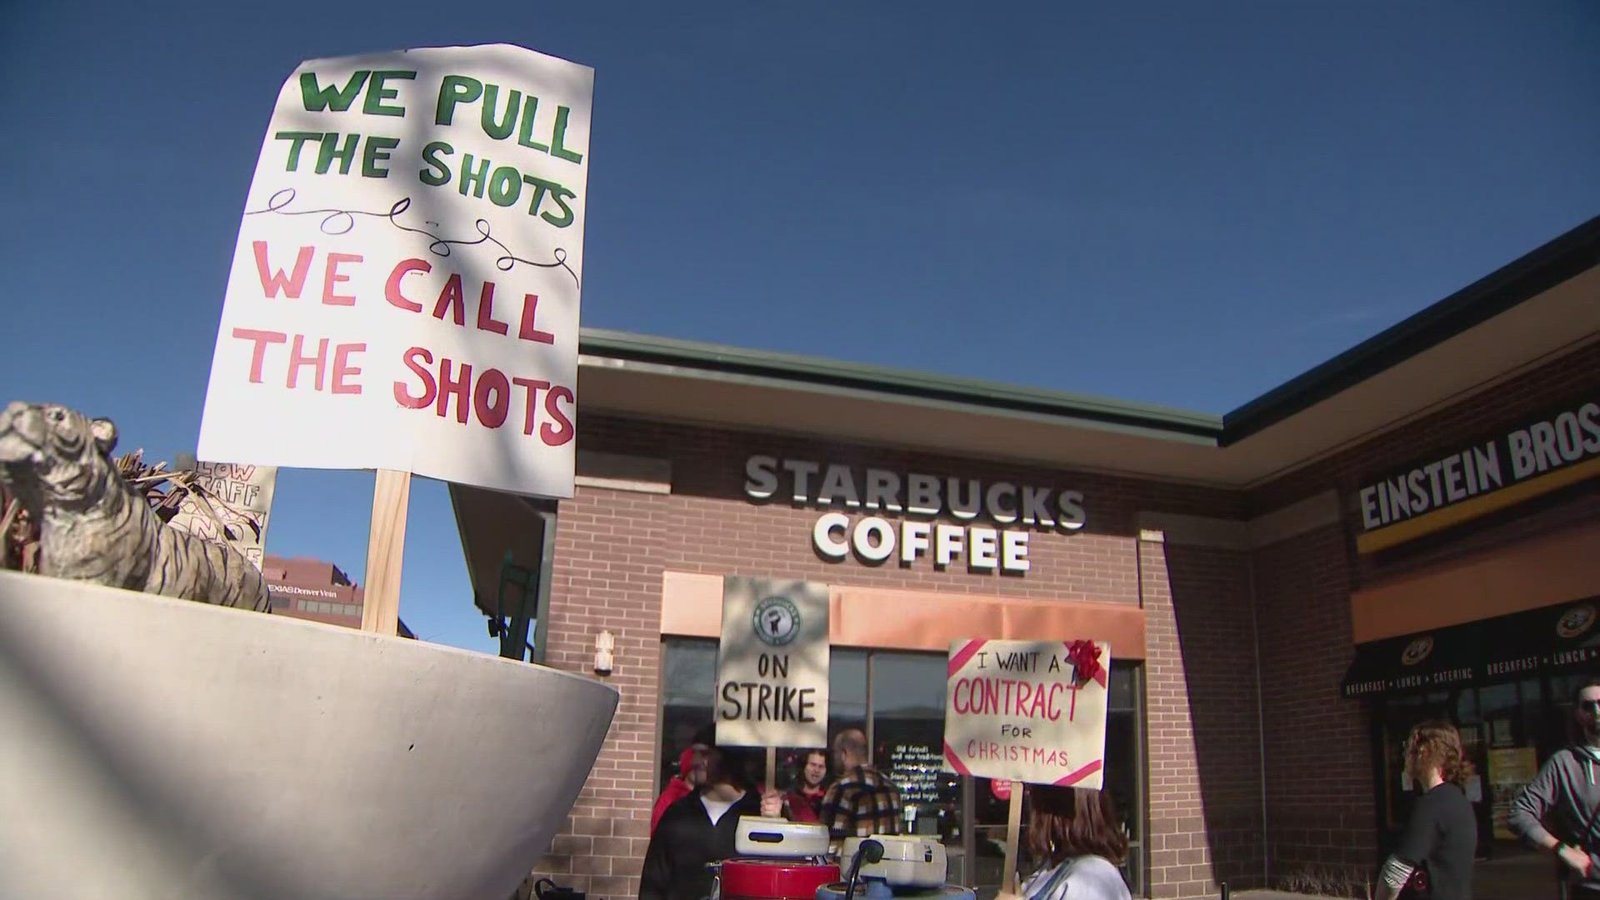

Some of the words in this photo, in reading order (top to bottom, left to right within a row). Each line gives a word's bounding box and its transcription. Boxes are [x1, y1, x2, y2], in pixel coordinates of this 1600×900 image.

[300, 71, 416, 117] WE
[435, 75, 583, 164] PULL
[275, 131, 400, 178] THE
[419, 141, 577, 228] SHOTS
[253, 240, 363, 306] WE
[384, 258, 554, 345] CALL
[232, 327, 367, 394] THE
[393, 346, 574, 447] SHOTS
[1359, 440, 1503, 530] EINSTEIN
[1507, 402, 1600, 480] BROS
[196, 475, 260, 506] TAFF
[744, 455, 1086, 529] STARBUCKS
[813, 513, 1030, 571] COFFEE
[758, 653, 789, 678] ON
[977, 652, 988, 669] I
[996, 652, 1040, 673] WANT
[1048, 654, 1060, 673] A
[1346, 680, 1385, 695] BREAKFAST
[1396, 676, 1421, 689] LUNCH
[1433, 668, 1472, 684] CATERING
[1487, 656, 1537, 675] BREAKFAST
[1553, 649, 1586, 665] LUNCH
[722, 681, 816, 723] STRIKE
[953, 677, 1082, 722] CONTRACT
[1001, 724, 1032, 738] FOR
[967, 739, 1068, 767] CHRISTMAS
